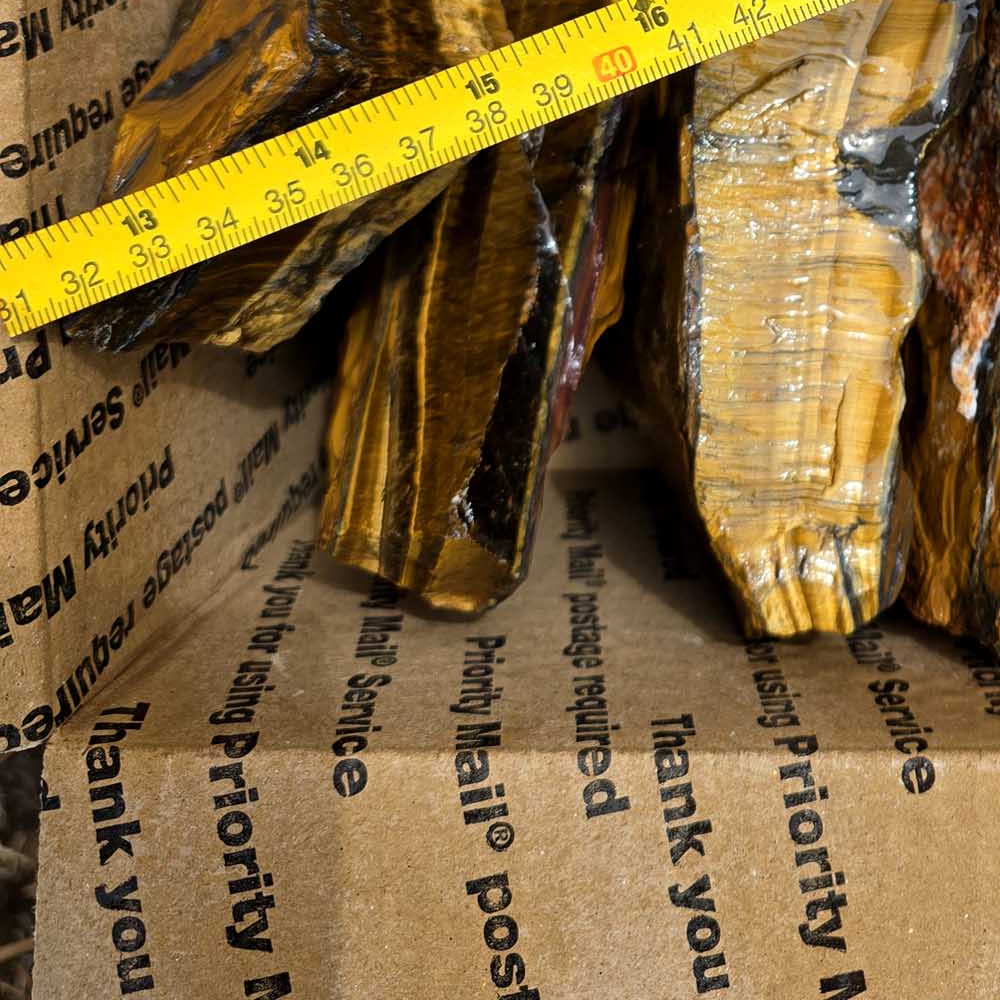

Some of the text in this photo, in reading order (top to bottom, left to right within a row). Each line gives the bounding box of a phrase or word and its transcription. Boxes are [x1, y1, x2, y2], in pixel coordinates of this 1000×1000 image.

[60, 261, 104, 296] 32
[129, 234, 171, 268] 33
[196, 206, 240, 241] 34
[264, 180, 307, 214] 35
[332, 153, 374, 187] 36
[399, 126, 437, 161] 37
[465, 100, 507, 134] 38
[532, 73, 574, 107] 39
[597, 50, 634, 79] 40
[667, 22, 703, 52] 41
[121, 208, 159, 237] 13
[294, 139, 331, 168] 14
[464, 72, 500, 100] 15
[635, 5, 669, 32] 16
[0, 385, 126, 506] Service
[84, 444, 176, 571] Priority
[142, 477, 230, 610] postage
[262, 583, 303, 620] you
[0, 602, 136, 756] required
[209, 659, 277, 728] using
[247, 623, 296, 654] for
[353, 613, 404, 668] Mail®
[450, 633, 508, 716] Priority
[561, 591, 609, 670] postage
[332, 672, 392, 798] Service
[565, 672, 632, 820] required
[752, 668, 801, 729] using
[868, 678, 937, 795] Service
[84, 699, 155, 996] Thank you
[208, 730, 276, 954] Priority
[453, 720, 516, 852] Mail®
[773, 733, 848, 954] Priority
[650, 713, 731, 995] Thank you
